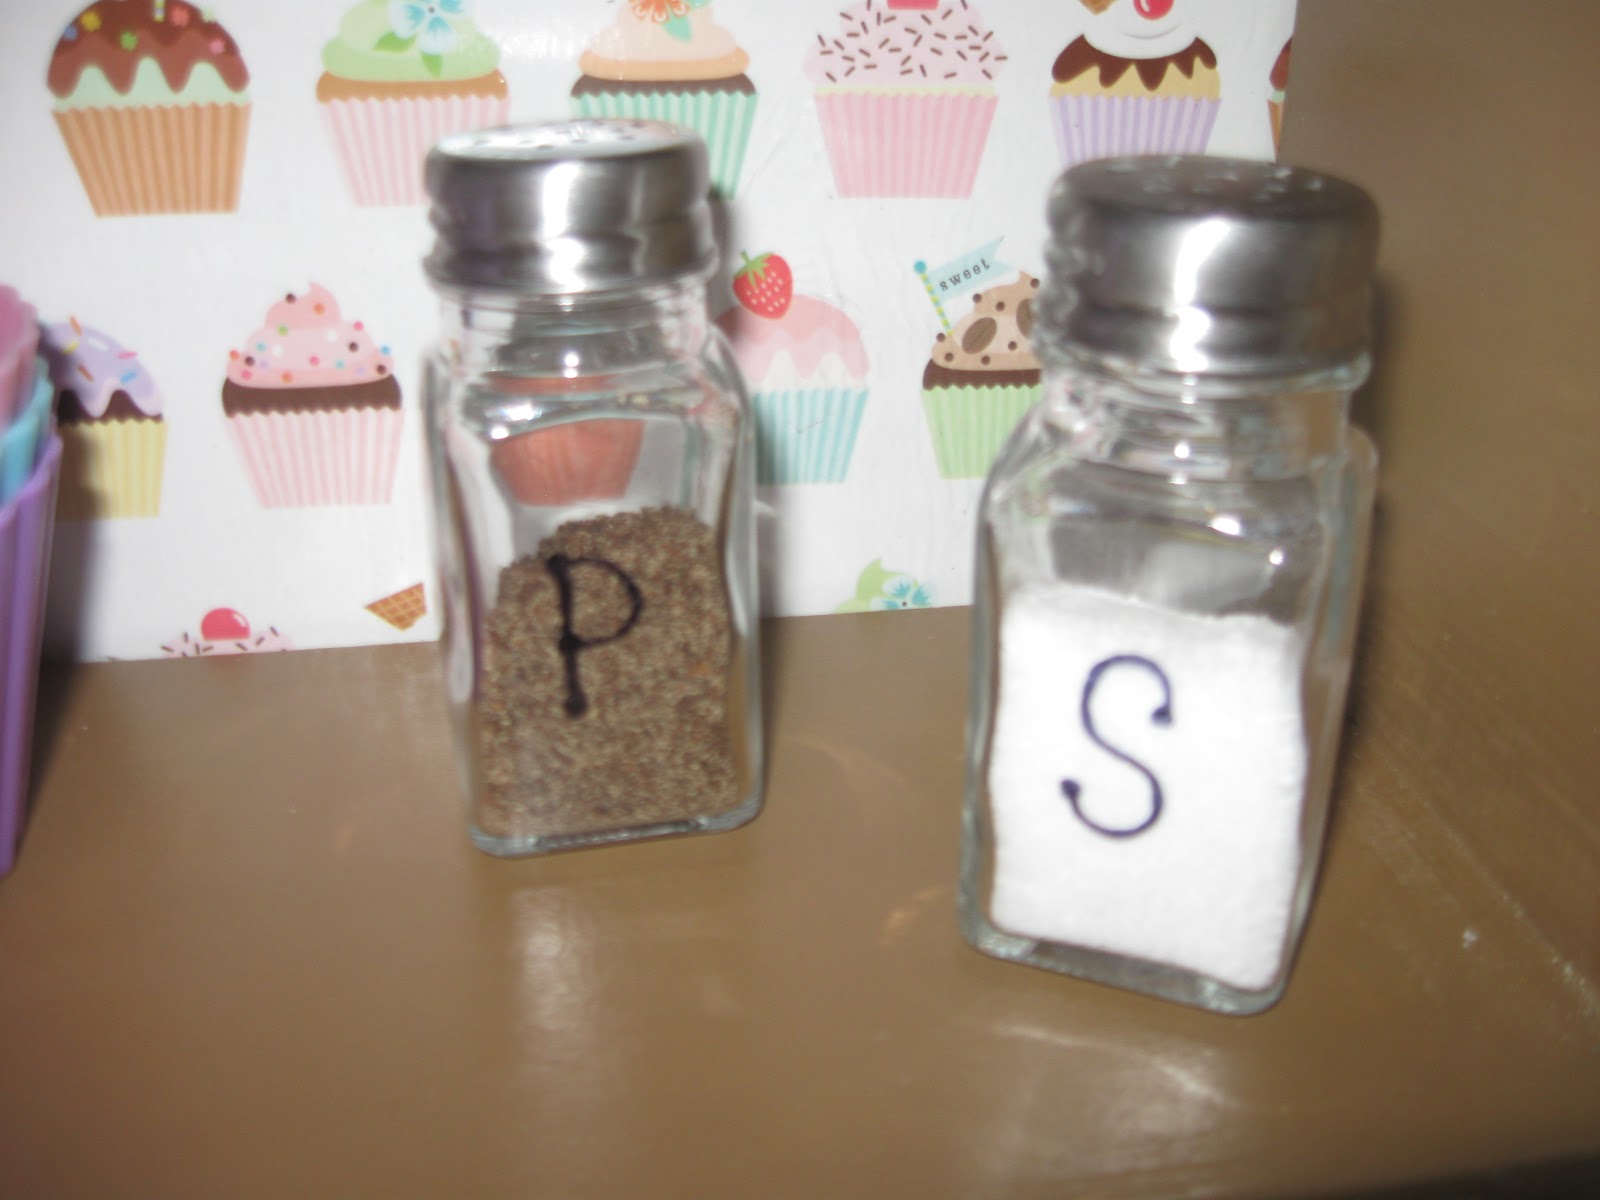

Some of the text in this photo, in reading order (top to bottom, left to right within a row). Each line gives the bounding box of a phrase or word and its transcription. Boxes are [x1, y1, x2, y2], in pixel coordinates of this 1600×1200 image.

[939, 258, 990, 291] sweet
[546, 554, 644, 718] P
[1060, 654, 1173, 839] S
